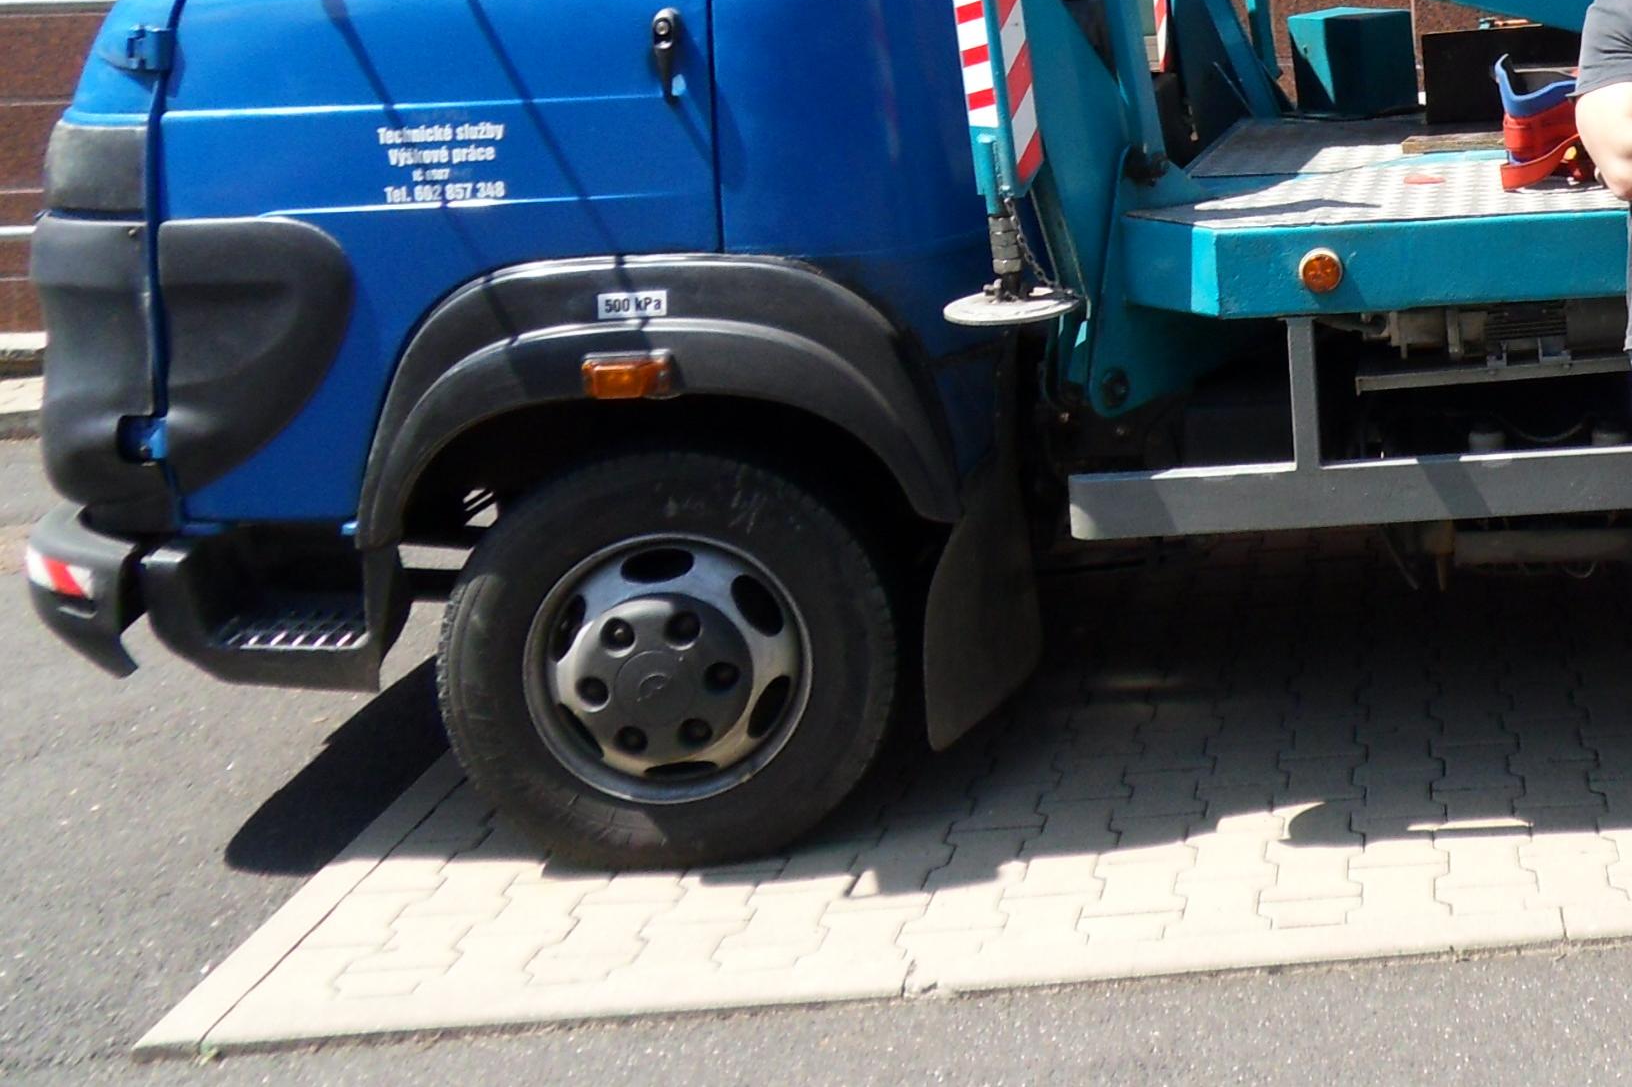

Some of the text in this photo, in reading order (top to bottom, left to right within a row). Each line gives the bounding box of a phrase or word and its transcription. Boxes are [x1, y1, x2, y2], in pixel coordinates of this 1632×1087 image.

[376, 121, 505, 145] Technické služby
[452, 144, 496, 164] práce
[384, 186, 412, 203] Tel.
[445, 182, 473, 200] 857
[475, 180, 506, 198] 348
[604, 296, 663, 314] 500 kPa
